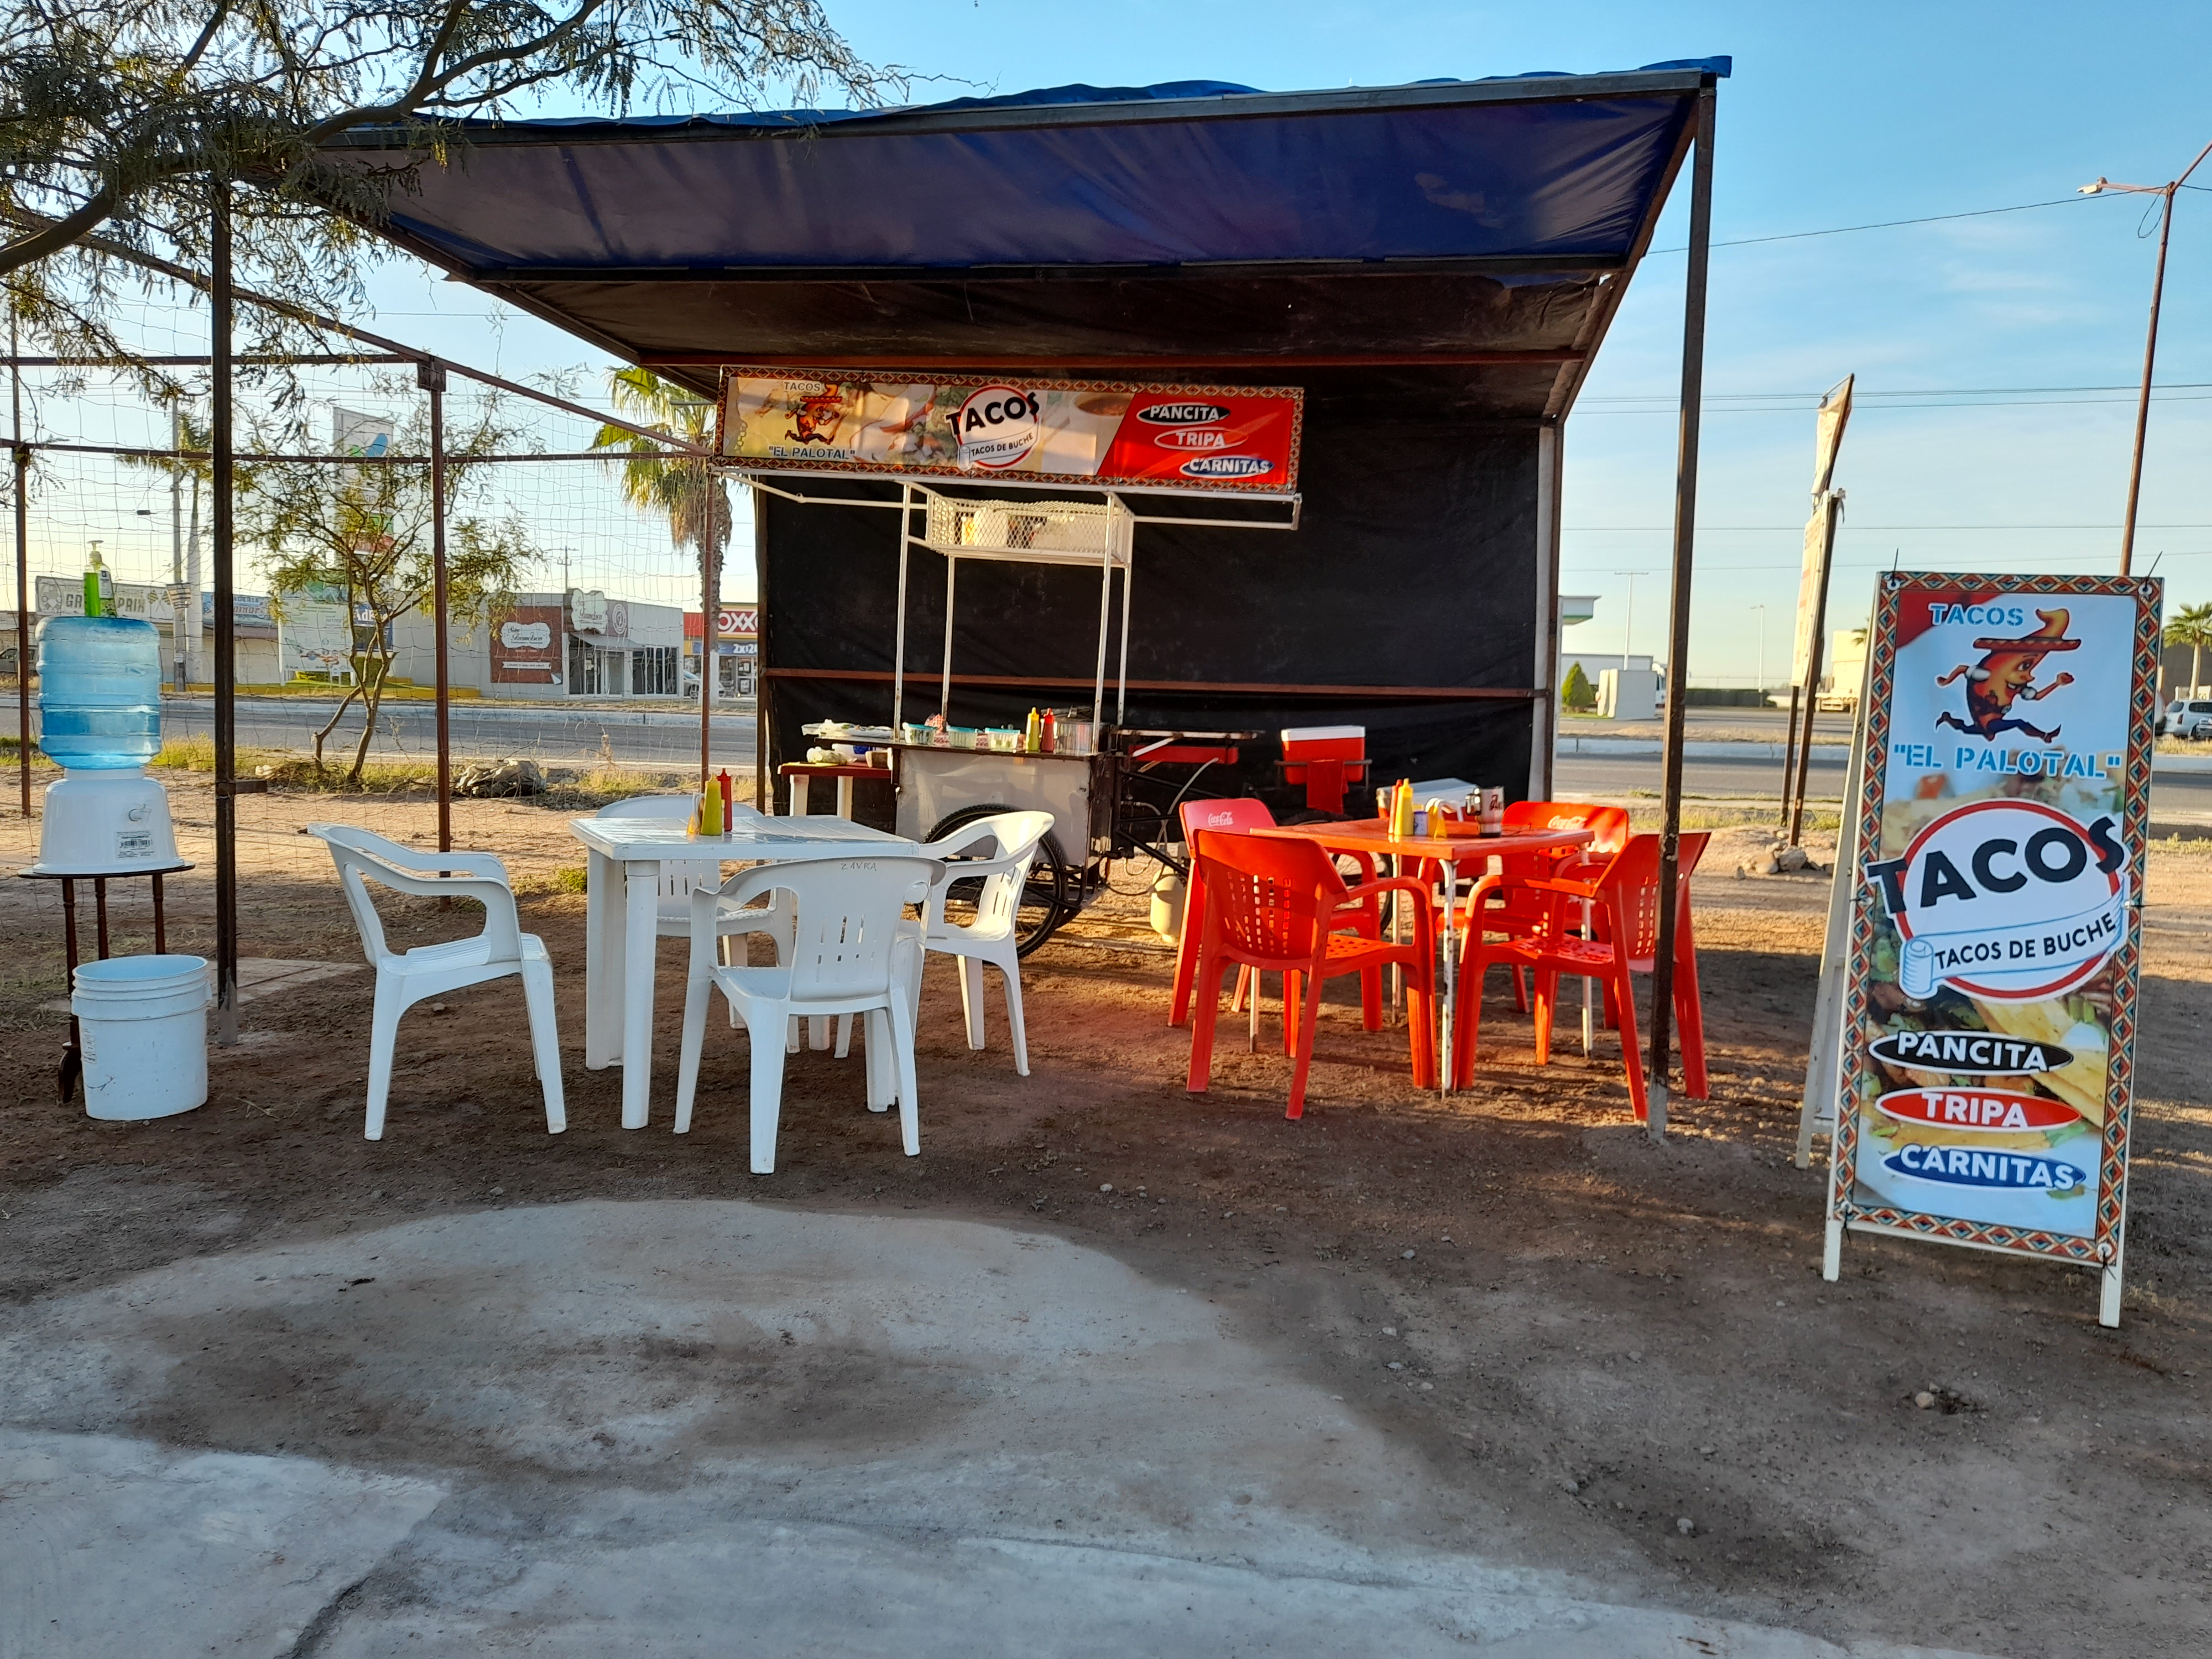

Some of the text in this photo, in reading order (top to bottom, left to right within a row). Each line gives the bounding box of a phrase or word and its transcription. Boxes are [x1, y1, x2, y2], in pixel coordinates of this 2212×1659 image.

[783, 382, 821, 392] TACOS
[946, 392, 1040, 435] TACOS
[1150, 404, 1220, 420] PANCITA
[971, 445, 994, 456] TACOS
[1009, 432, 1033, 449] BUCHE
[1175, 432, 1225, 447] TRIPA
[792, 447, 855, 460] PALOTAL"
[1190, 458, 1271, 474] CARNITAS
[718, 611, 758, 633] OXX
[1929, 604, 2023, 626] TACOS
[1893, 744, 2121, 779] "EL PALOTAL"
[1867, 816, 2125, 914] TACOS
[1936, 913, 2117, 969] TACOS DE BUCHE
[1897, 1031, 2048, 1071] PANCITA
[1921, 1092, 2028, 1129] TRIPA
[1900, 1144, 2077, 1191] CARNITAS
